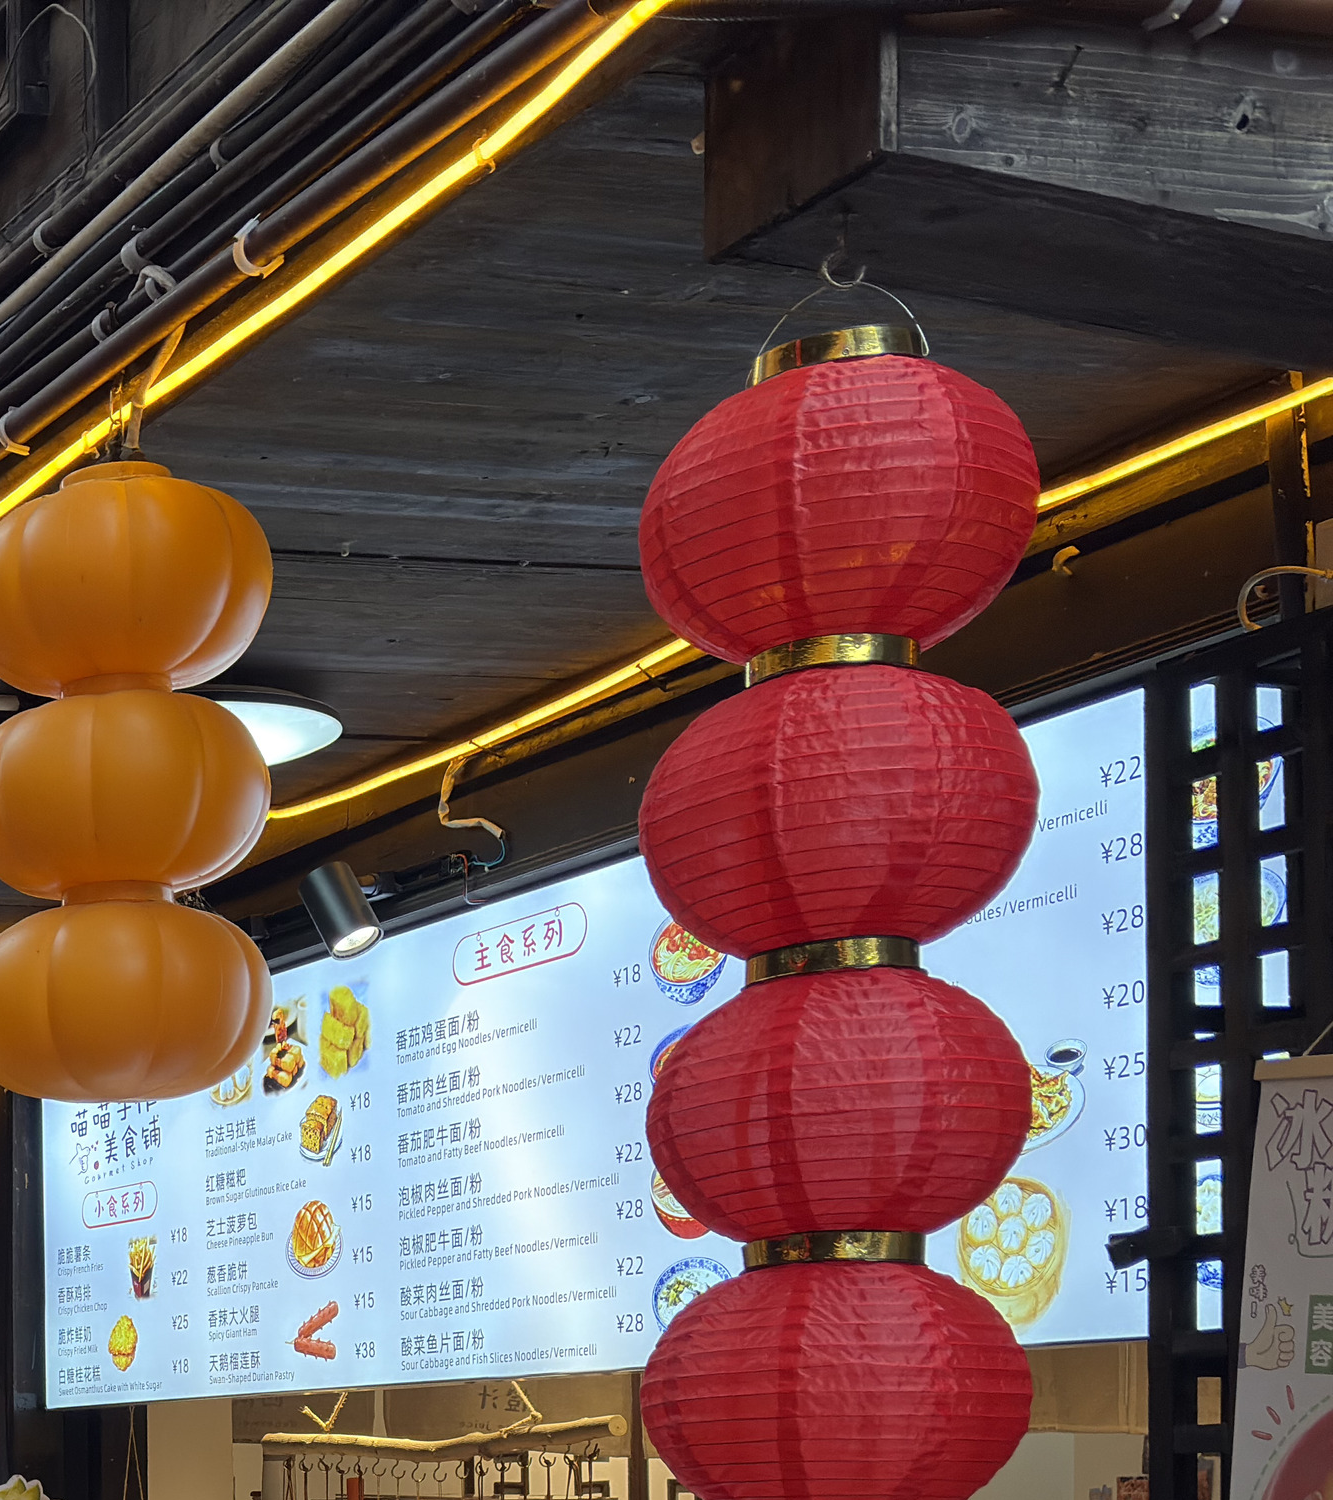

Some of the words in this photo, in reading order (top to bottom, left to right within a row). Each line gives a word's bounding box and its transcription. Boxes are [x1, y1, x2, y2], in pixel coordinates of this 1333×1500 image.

[1100, 756, 1142, 788] ¥22
[1101, 832, 1146, 863] ¥28
[1101, 905, 1144, 934] ¥28
[475, 919, 562, 971] 主食系列
[613, 964, 641, 987] ¥18
[1102, 980, 1145, 1008] ¥20
[396, 1010, 479, 1052] 番茄鸡蛋面/粉
[396, 1050, 424, 1064] Tomato
[425, 1044, 440, 1057] and
[442, 1042, 456, 1054] Egg
[459, 1018, 537, 1049] Noodles/Vermicelli
[614, 1025, 641, 1048] ¥22
[1103, 1052, 1146, 1080] ¥25
[397, 1066, 480, 1105] 番茄肉丝面/粉
[615, 1082, 642, 1104] ¥28
[350, 1092, 370, 1111] ¥18
[104, 1115, 161, 1163] 美食铺
[205, 1117, 256, 1146] 古法马拉糕
[397, 1118, 481, 1154] 番茄肥牛面/粉
[1104, 1124, 1147, 1151] ¥30
[351, 1144, 371, 1163] ¥18
[615, 1142, 642, 1163] ¥22
[84, 1164, 125, 1184] Gourmet
[131, 1156, 153, 1170] Shop
[206, 1169, 246, 1192] 红糖糍粑
[398, 1172, 482, 1207] 泡椒肉丝面/粉
[399, 1206, 425, 1220] Pickled
[427, 1204, 454, 1216] Pepper
[456, 1198, 471, 1211] and
[473, 1191, 511, 1208] Shredded
[514, 1188, 532, 1200] Pork
[534, 1173, 619, 1197] Noodles/Vermicelli
[95, 1191, 144, 1218] 小食系列
[351, 1194, 371, 1212] ¥15
[616, 1199, 643, 1220] ¥28
[1105, 1196, 1147, 1222] ¥18
[171, 1228, 187, 1243] ¥18
[206, 1212, 257, 1236] 芝士菠萝包
[399, 1224, 483, 1256] 泡椒肥牛面/粉
[58, 1245, 91, 1264] 脆脆薯条
[352, 1246, 372, 1264] ¥15
[616, 1256, 643, 1276] ¥22
[171, 1270, 187, 1286] ¥22
[207, 1261, 247, 1283] 葱香脆饼
[1105, 1266, 1147, 1294] ¥15
[58, 1284, 91, 1303] 香酥鸡排
[354, 1292, 374, 1310] ¥15
[400, 1276, 483, 1306] 酸菜肉丝面/粉
[172, 1314, 188, 1330] ¥25
[208, 1305, 259, 1328] 香辣大火腿
[617, 1313, 643, 1333] ¥28
[59, 1326, 91, 1344] 脆炸鲜奶
[401, 1329, 484, 1356] 酸菜鱼片面/粉
[209, 1351, 260, 1372] 天鹅榴莲酥
[355, 1342, 375, 1358] ¥38
[59, 1365, 101, 1385] 白糖桂花糕
[172, 1359, 189, 1374] ¥18
